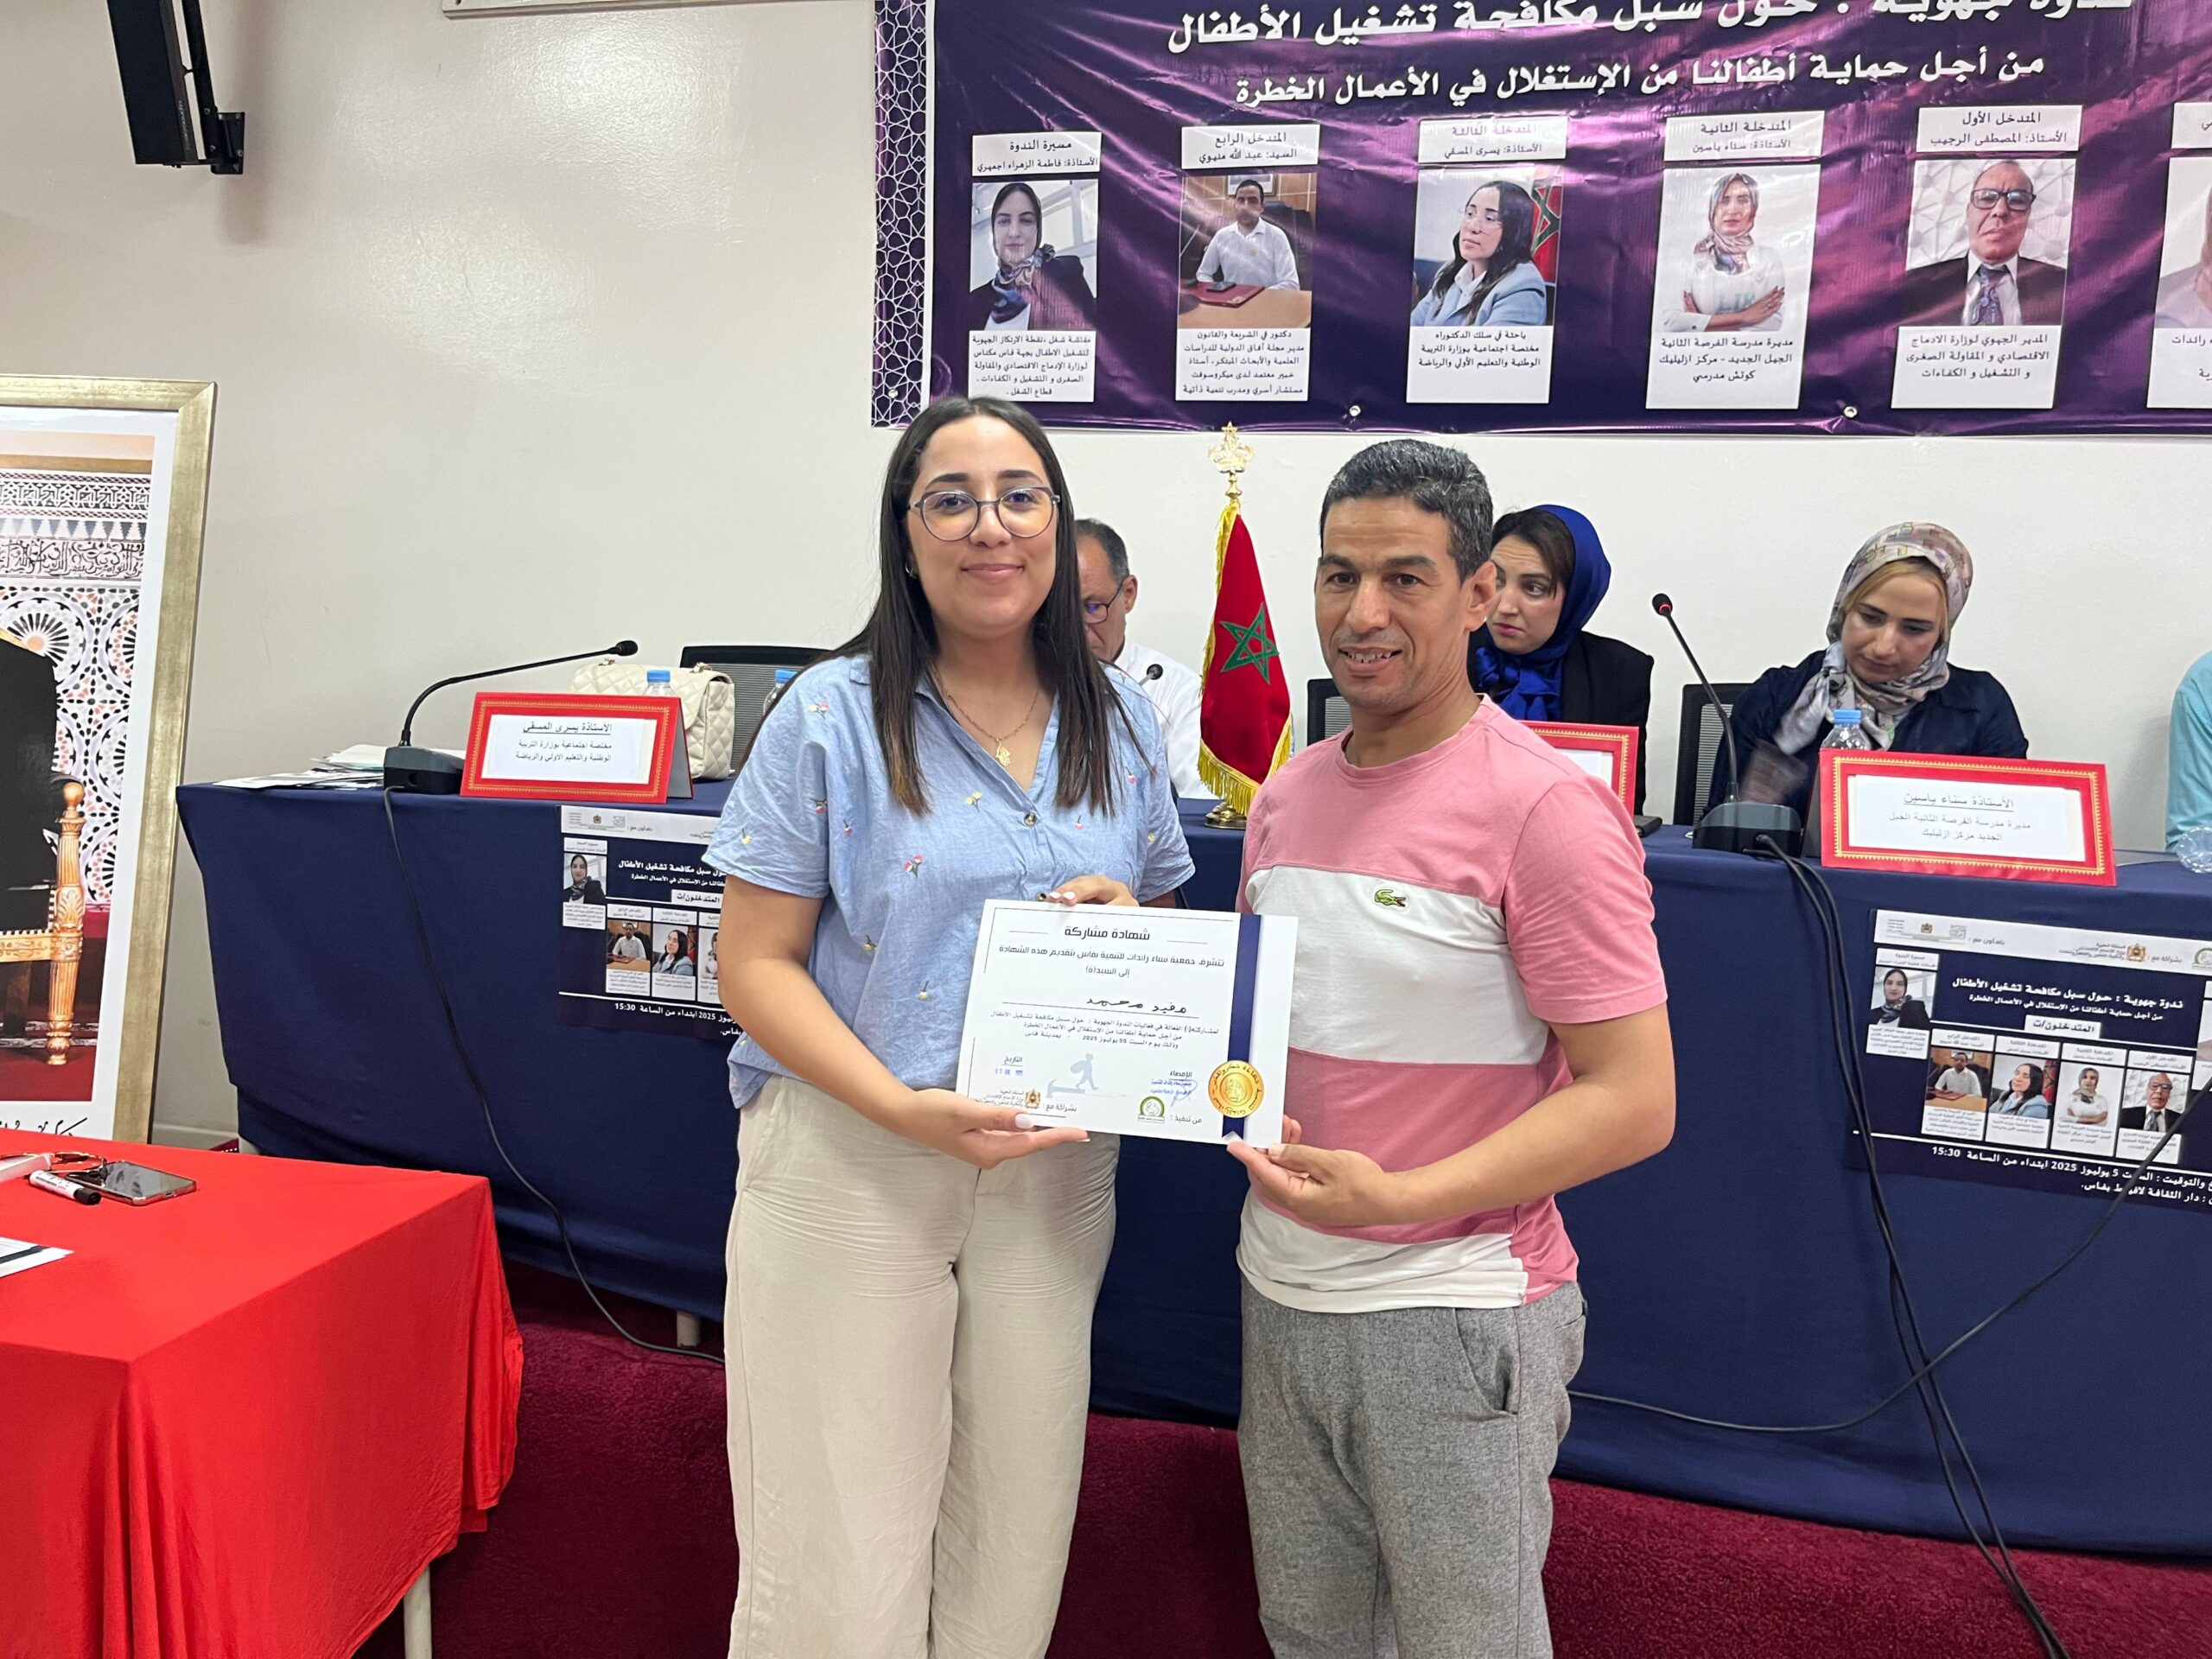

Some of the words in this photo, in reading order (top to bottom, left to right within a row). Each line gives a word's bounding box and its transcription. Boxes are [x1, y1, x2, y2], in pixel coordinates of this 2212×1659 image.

[1452, 0, 1600, 37] مكافحة
[1611, 0, 1707, 33] سبل
[1165, 3, 1303, 54] الأطفال
[1314, 3, 1440, 46] تشغيل
[1692, 50, 1796, 86] أطفالنا
[1808, 52, 1910, 86] حماية
[1919, 45, 1987, 83] أجل
[1998, 51, 2044, 82] من
[1497, 62, 1630, 99] الإستغلال
[1641, 63, 1681, 94] من
[1335, 66, 1439, 105] الأعمال
[1449, 68, 1487, 107] في
[1233, 75, 1325, 111] الخطرة
[1961, 110, 1991, 127] الأول
[1995, 111, 2041, 126] المتدخل
[1700, 121, 1738, 137] الثانية
[1743, 118, 1792, 132] المتدخلة
[1214, 132, 1244, 149] الرابع
[1247, 130, 1287, 145] المتدخل
[1974, 131, 2021, 147] المصطفى
[2024, 129, 2068, 143] الأستاذ:
[1009, 138, 1039, 153] الندوة
[1042, 139, 1072, 152] مسيرة
[1503, 142, 1542, 154] الأستاذة:
[1692, 141, 1721, 154] ياسين
[1724, 140, 1747, 151] سناء
[1750, 137, 1791, 149] الأستاذة:
[1229, 147, 1242, 160] الله
[1244, 151, 1263, 162] عبد
[1475, 147, 1501, 157] يسرى
[1007, 159, 1034, 172] الزهراء
[1037, 158, 1062, 168] فاطمة
[1196, 330, 1228, 340] والقانون
[1230, 329, 1259, 341] الشريعة
[1269, 329, 1293, 340] دكتور
[1434, 330, 1471, 341] الدكتوراه
[1472, 331, 1492, 340] سلك
[1494, 330, 1503, 342] في
[1504, 330, 1527, 340] باحثة
[1949, 334, 1980, 347] لوزارة
[1980, 334, 2018, 347] الجهوي
[2018, 334, 2049, 346] المدير
[1266, 343, 1285, 353] مجلة
[1286, 345, 1305, 353] مدير
[1661, 337, 1691, 349] الثانية
[1694, 337, 1729, 350] الفرصة
[1731, 337, 1764, 350] مدرسة
[1766, 337, 1794, 350] مديرة
[973, 347, 997, 359] مكناس
[998, 348, 1014, 359] فاس
[1447, 344, 1471, 355] بوزارة
[1694, 353, 1718, 366] مركز
[1727, 353, 1762, 365] الجديد
[1764, 353, 1793, 365] الجيل
[1905, 350, 1946, 364] الصغرى
[1948, 350, 1985, 363] المقاولة
[1476, 357, 1509, 370] والتعليم
[1510, 357, 1541, 369] الوطنية
[1692, 372, 1726, 384] مدرسي
[1727, 369, 1757, 382] كوتش
[1921, 366, 1967, 378] الكفاءات
[1979, 367, 2021, 379] التشغيل
[618, 860, 644, 868] الأطفال
[645, 862, 668, 871] تشغيل
[669, 863, 695, 873] مكافحة
[1064, 926, 1109, 940] مشاركة
[1111, 928, 1151, 941] شهادة
[998, 944, 1030, 954] الشهادة
[1048, 948, 1076, 957] بتقديم
[1100, 951, 1125, 960] للتنمية
[1126, 953, 1150, 964] رائدات
[1150, 955, 1169, 963] نساء
[1198, 957, 1225, 969] تتشرف
[1117, 968, 1130, 979] إلى
[1952, 977, 1988, 988] الأطفال
[1990, 982, 2023, 993] تشغيل
[2024, 984, 2062, 996] مكافحة
[2063, 988, 2087, 1000] سبل
[2087, 991, 2113, 1002] حول
[2123, 995, 2158, 1008] جهوية
[614, 1002, 636, 1011] 15:30
[639, 1004, 664, 1014] الساعة
[2158, 998, 2183, 1009] ندوة
[698, 1011, 716, 1020] 2025
[1931, 1146, 1961, 1158] 15:30
[1967, 1150, 2000, 1162] الساعة
[2002, 1157, 2018, 1166] من
[2019, 1157, 2049, 1170] ابتداء
[2050, 1160, 2077, 1172] 2025
[2080, 1165, 2110, 1178] يوليوز
[2121, 1171, 2153, 1181] الست
[2162, 1176, 2206, 1190] والتوقيت
[2147, 1187, 2182, 1199] الثقافة
[2183, 1192, 2200, 1203] دار
